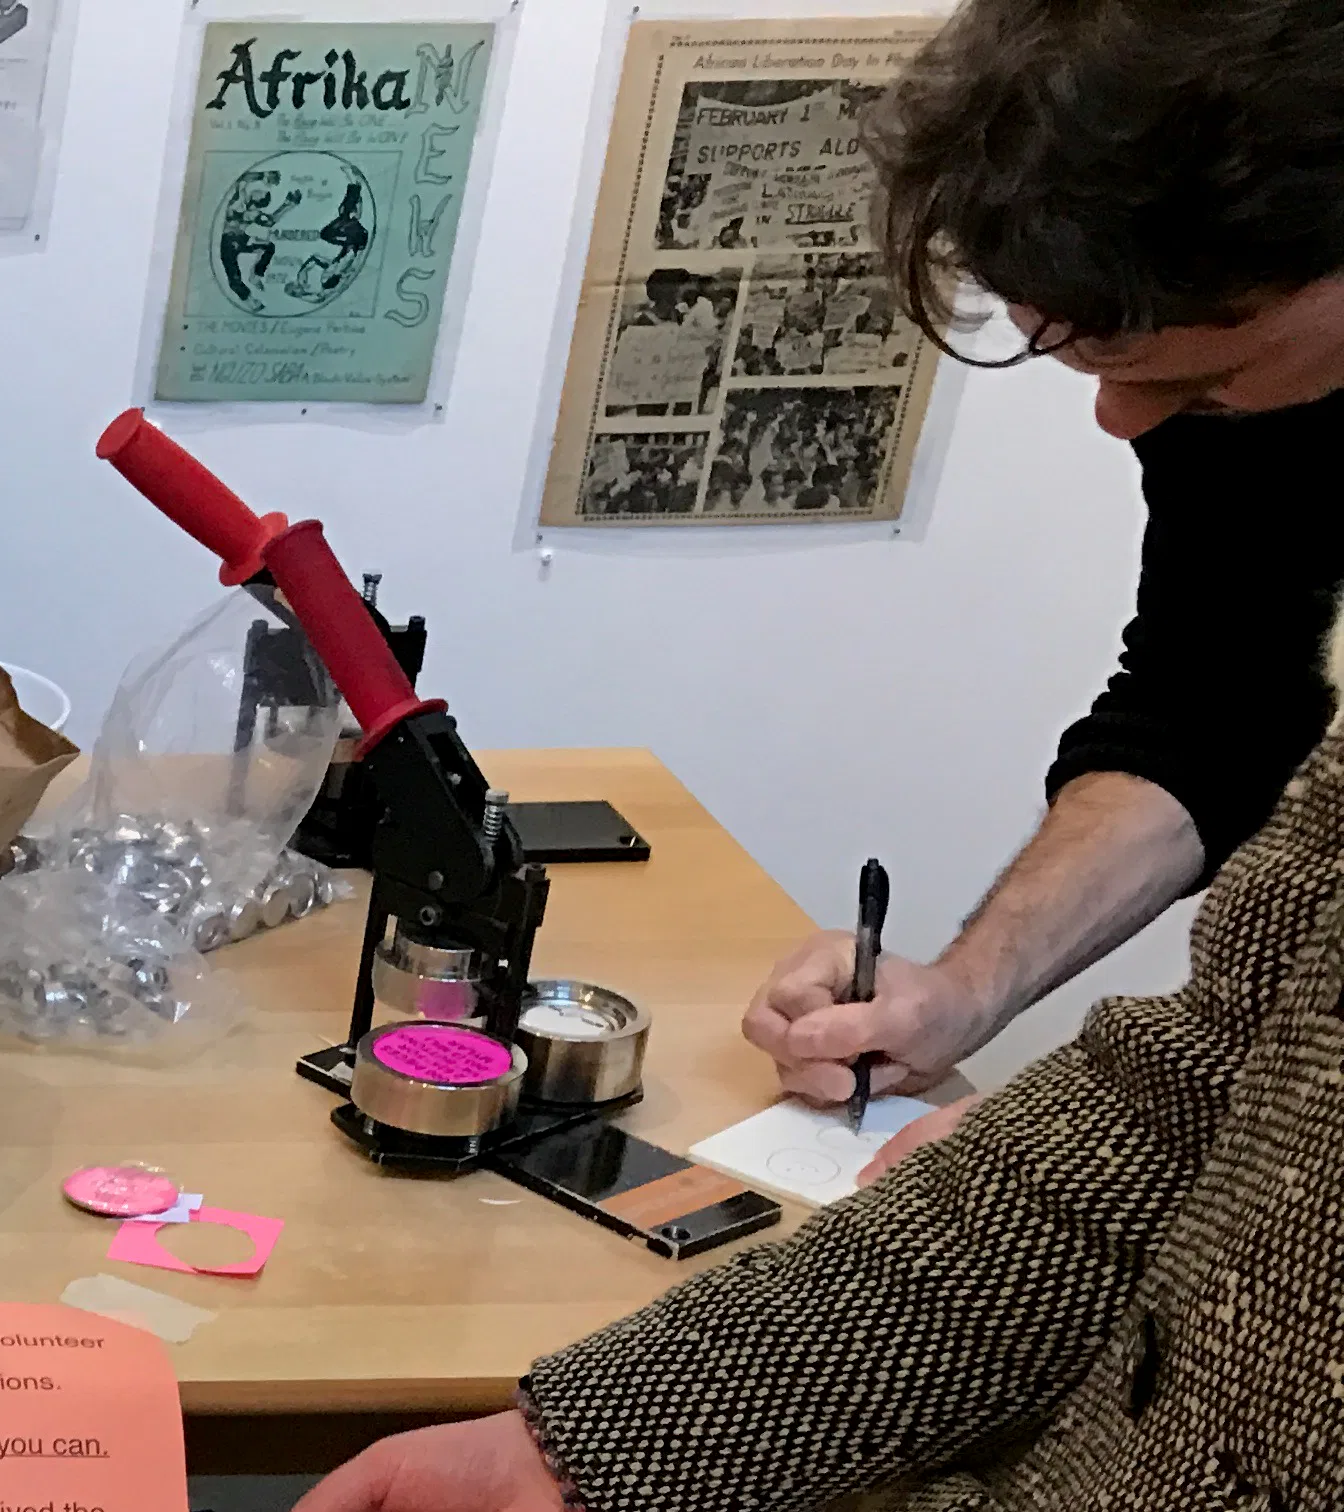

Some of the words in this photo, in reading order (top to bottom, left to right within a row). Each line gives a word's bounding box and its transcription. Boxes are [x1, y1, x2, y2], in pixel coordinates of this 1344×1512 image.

[205, 37, 411, 118] Afrika
[696, 106, 790, 127] FEBRUARY
[697, 139, 802, 164] SUPPORTS
[384, 40, 486, 328] NEWS
[52, 1436, 109, 1456] can.
